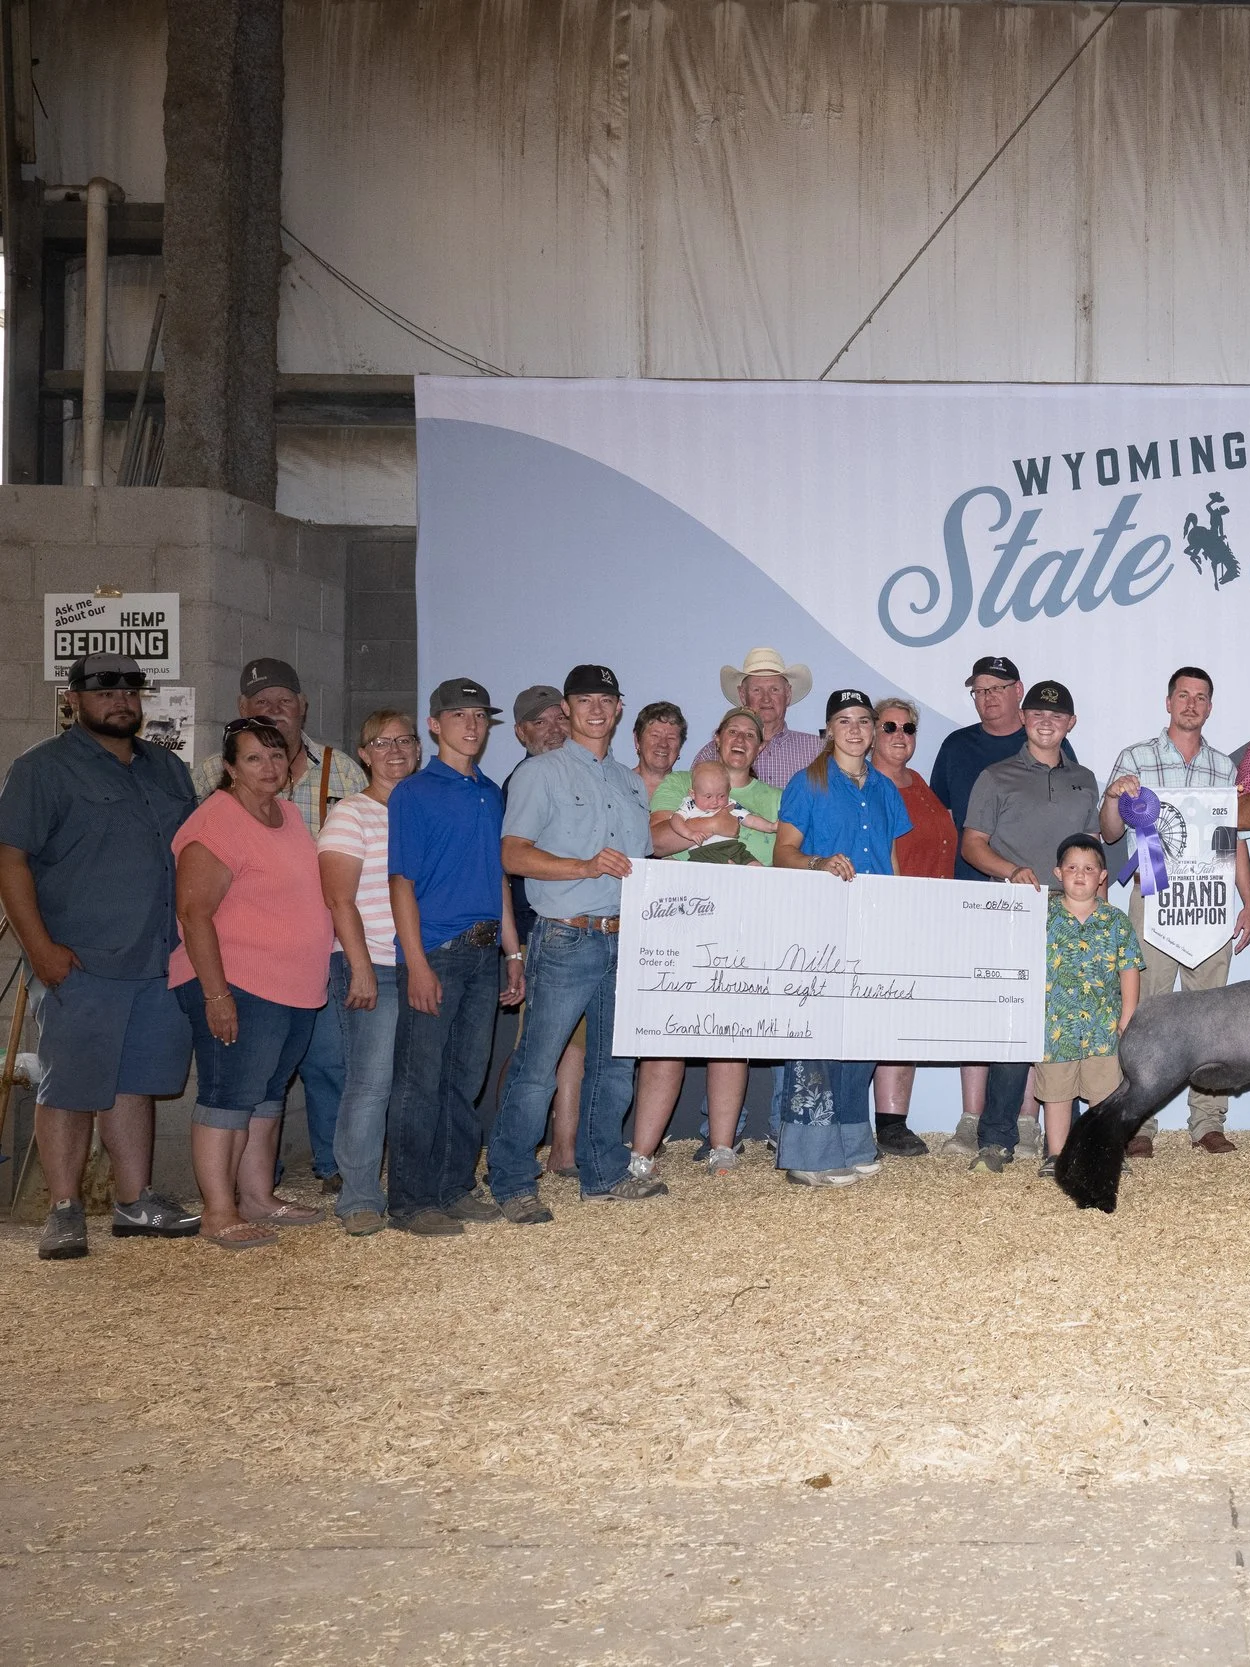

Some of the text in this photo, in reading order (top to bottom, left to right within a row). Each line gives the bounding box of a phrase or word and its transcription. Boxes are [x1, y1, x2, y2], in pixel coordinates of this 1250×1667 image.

[1013, 431, 1247, 497] WYOMING
[877, 485, 1174, 648] State
[55, 599, 93, 617] Ask me
[55, 605, 106, 627] about our
[120, 612, 166, 627] HEMP
[56, 631, 164, 656] BEDDING
[1212, 807, 1228, 815] 2025
[1158, 880, 1227, 908] GRAND
[641, 896, 716, 921] State Fair
[962, 901, 983, 909] Date:
[985, 899, 1023, 910] 08/15/25
[1157, 907, 1227, 926] CHAMPION
[640, 947, 654, 956] Pay
[776, 943, 861, 974] Miller
[639, 958, 675, 967] Order of:
[650, 970, 916, 1007] Two thousand eight hundred
[998, 995, 1025, 1004] Dollars
[635, 1027, 662, 1036] Memo
[665, 1014, 701, 1035] Grand
[703, 1012, 752, 1043] Champion
